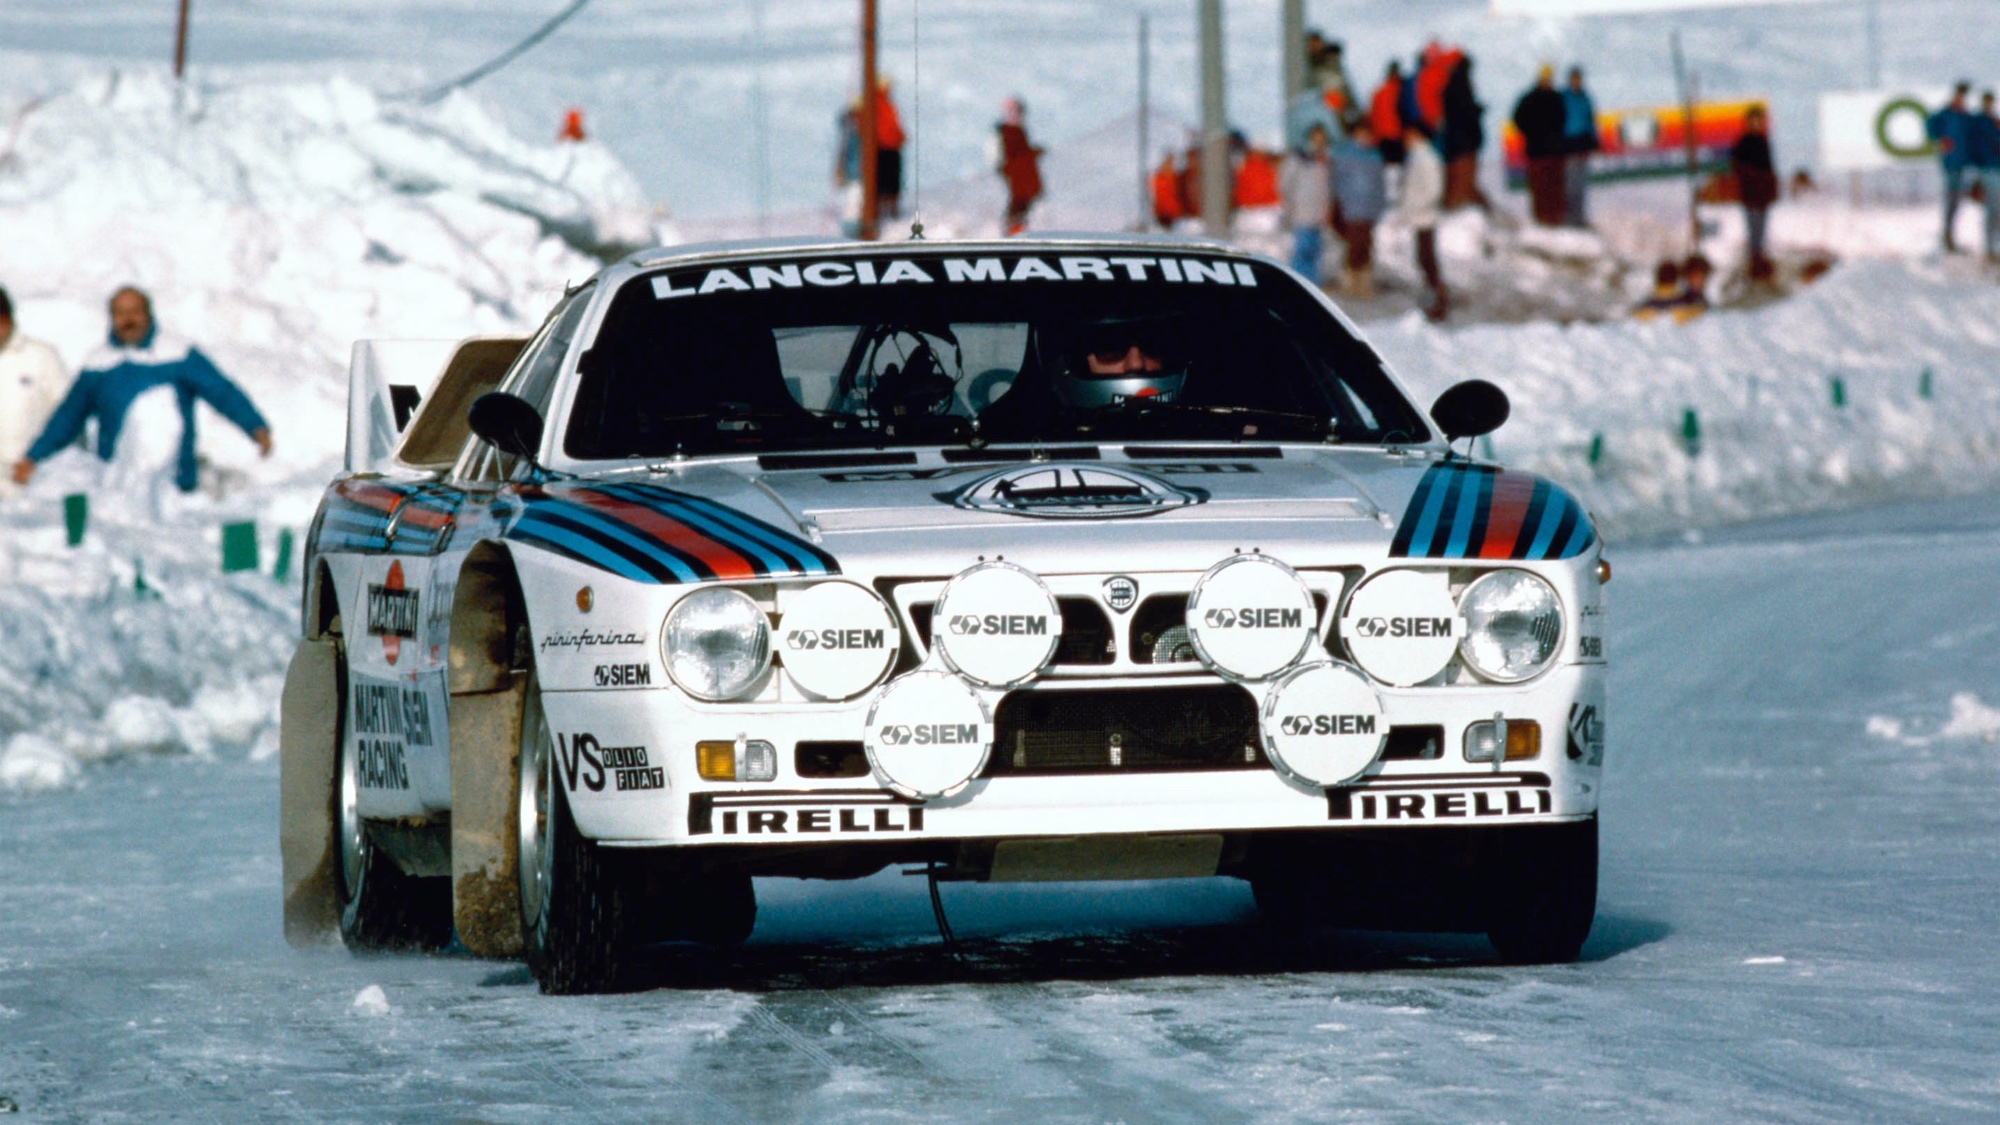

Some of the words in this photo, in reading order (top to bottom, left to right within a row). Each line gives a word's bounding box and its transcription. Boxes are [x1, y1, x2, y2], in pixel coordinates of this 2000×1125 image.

[651, 260, 932, 300] LANCIA
[944, 256, 1257, 288] MARTINI
[368, 590, 418, 638] MARTINI
[983, 616, 1047, 635] SIEM
[1238, 609, 1302, 628] SIEM
[1390, 617, 1452, 637] SIEM
[541, 629, 645, 653] pininfarina
[821, 629, 884, 650] SIEM
[611, 664, 651, 685] SIEM
[355, 684, 403, 734] MARTINI
[403, 689, 433, 746] SIEM
[1314, 714, 1376, 735] SIEM
[914, 725, 978, 745] SIEM
[358, 738, 410, 790] RACING
[558, 733, 606, 792] VS
[602, 747, 648, 768] OLIO
[616, 767, 664, 791] FIAT
[1326, 773, 1551, 820] PIRELLI
[688, 789, 924, 835] PIRELLI
